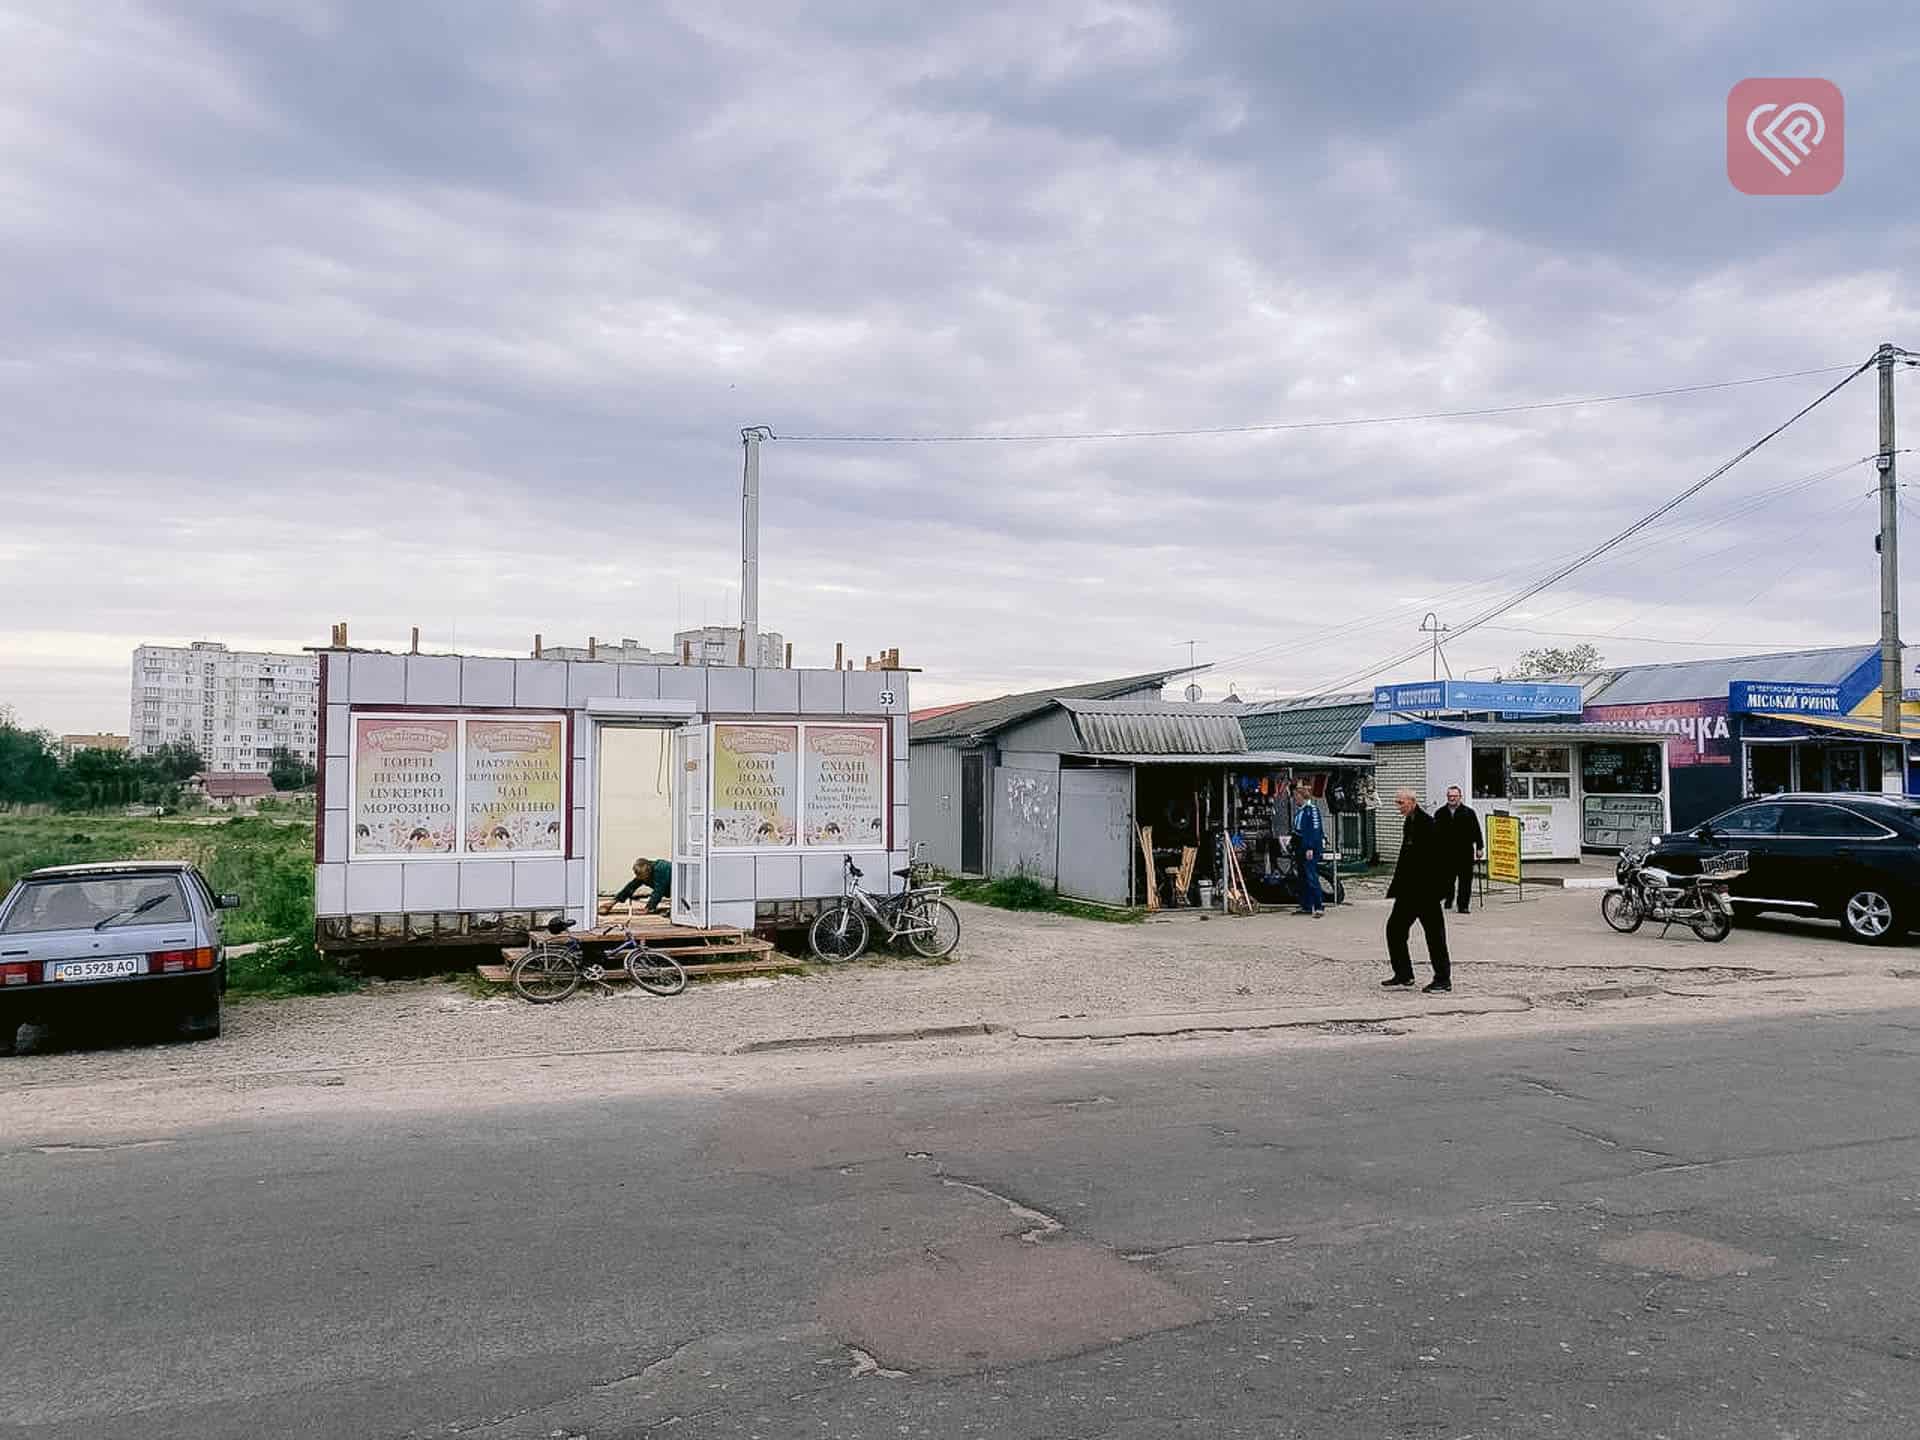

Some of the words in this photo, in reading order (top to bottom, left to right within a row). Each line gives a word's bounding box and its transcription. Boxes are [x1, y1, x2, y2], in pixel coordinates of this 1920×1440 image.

[880, 692, 894, 705] 53
[1747, 692, 1798, 708] МІСЬКИЙ
[1800, 695, 1839, 711] РИНОК
[381, 757, 433, 768] ТОРТИ
[737, 759, 775, 770] СОКИ
[374, 772, 441, 783] ПЕЧИВО
[738, 773, 775, 784] ВОДА
[369, 788, 443, 799] ЦУКЕРКИ
[726, 786, 785, 798] СОЛОДКІ
[362, 803, 451, 814] МОРОЗИВО
[470, 802, 554, 813] КАПУЧИНО
[64, 964, 82, 977] CB
[85, 961, 113, 975] 5928
[116, 960, 134, 973] AO
